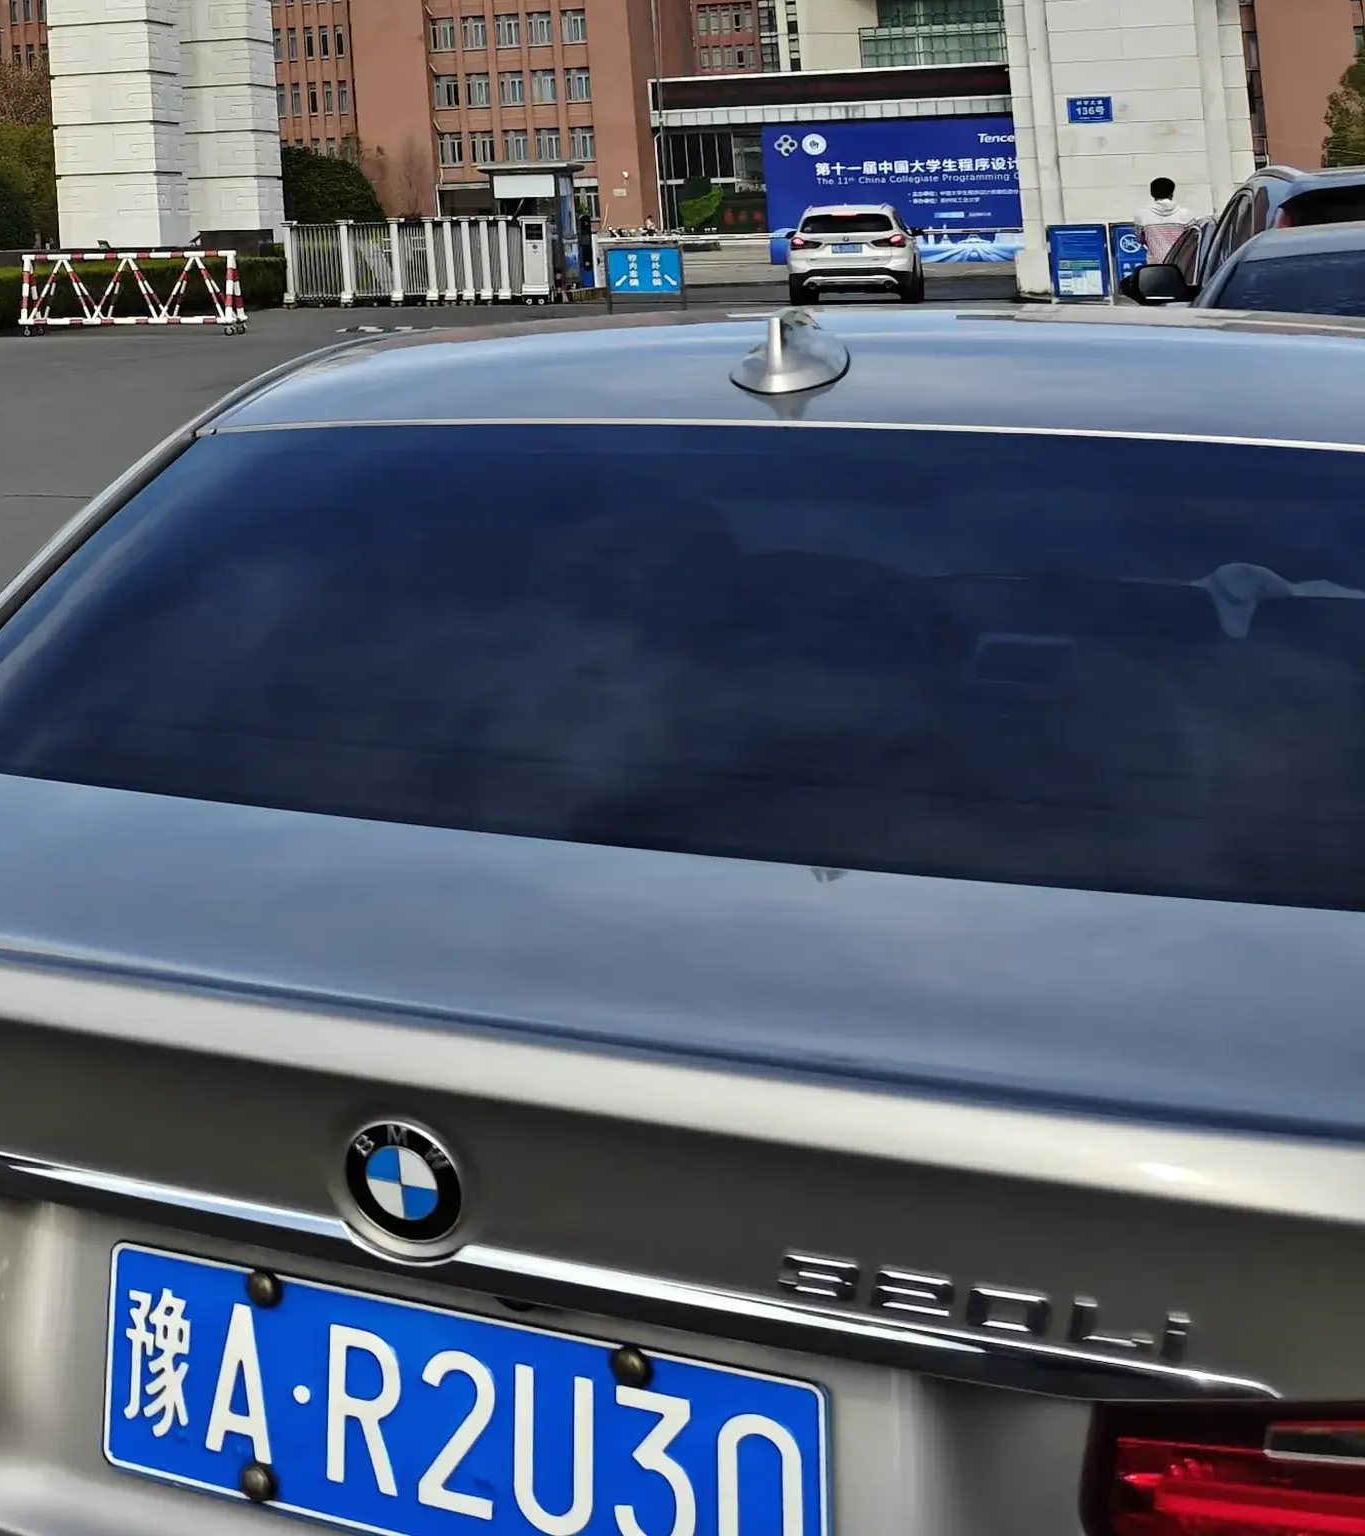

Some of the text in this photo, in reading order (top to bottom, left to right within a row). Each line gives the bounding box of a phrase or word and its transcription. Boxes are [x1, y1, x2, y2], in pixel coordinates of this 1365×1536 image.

[817, 176, 835, 185] The
[858, 174, 886, 184] China
[888, 173, 939, 185] Collegiate
[941, 171, 1011, 183] Programming
[354, 1124, 451, 1170] BMW
